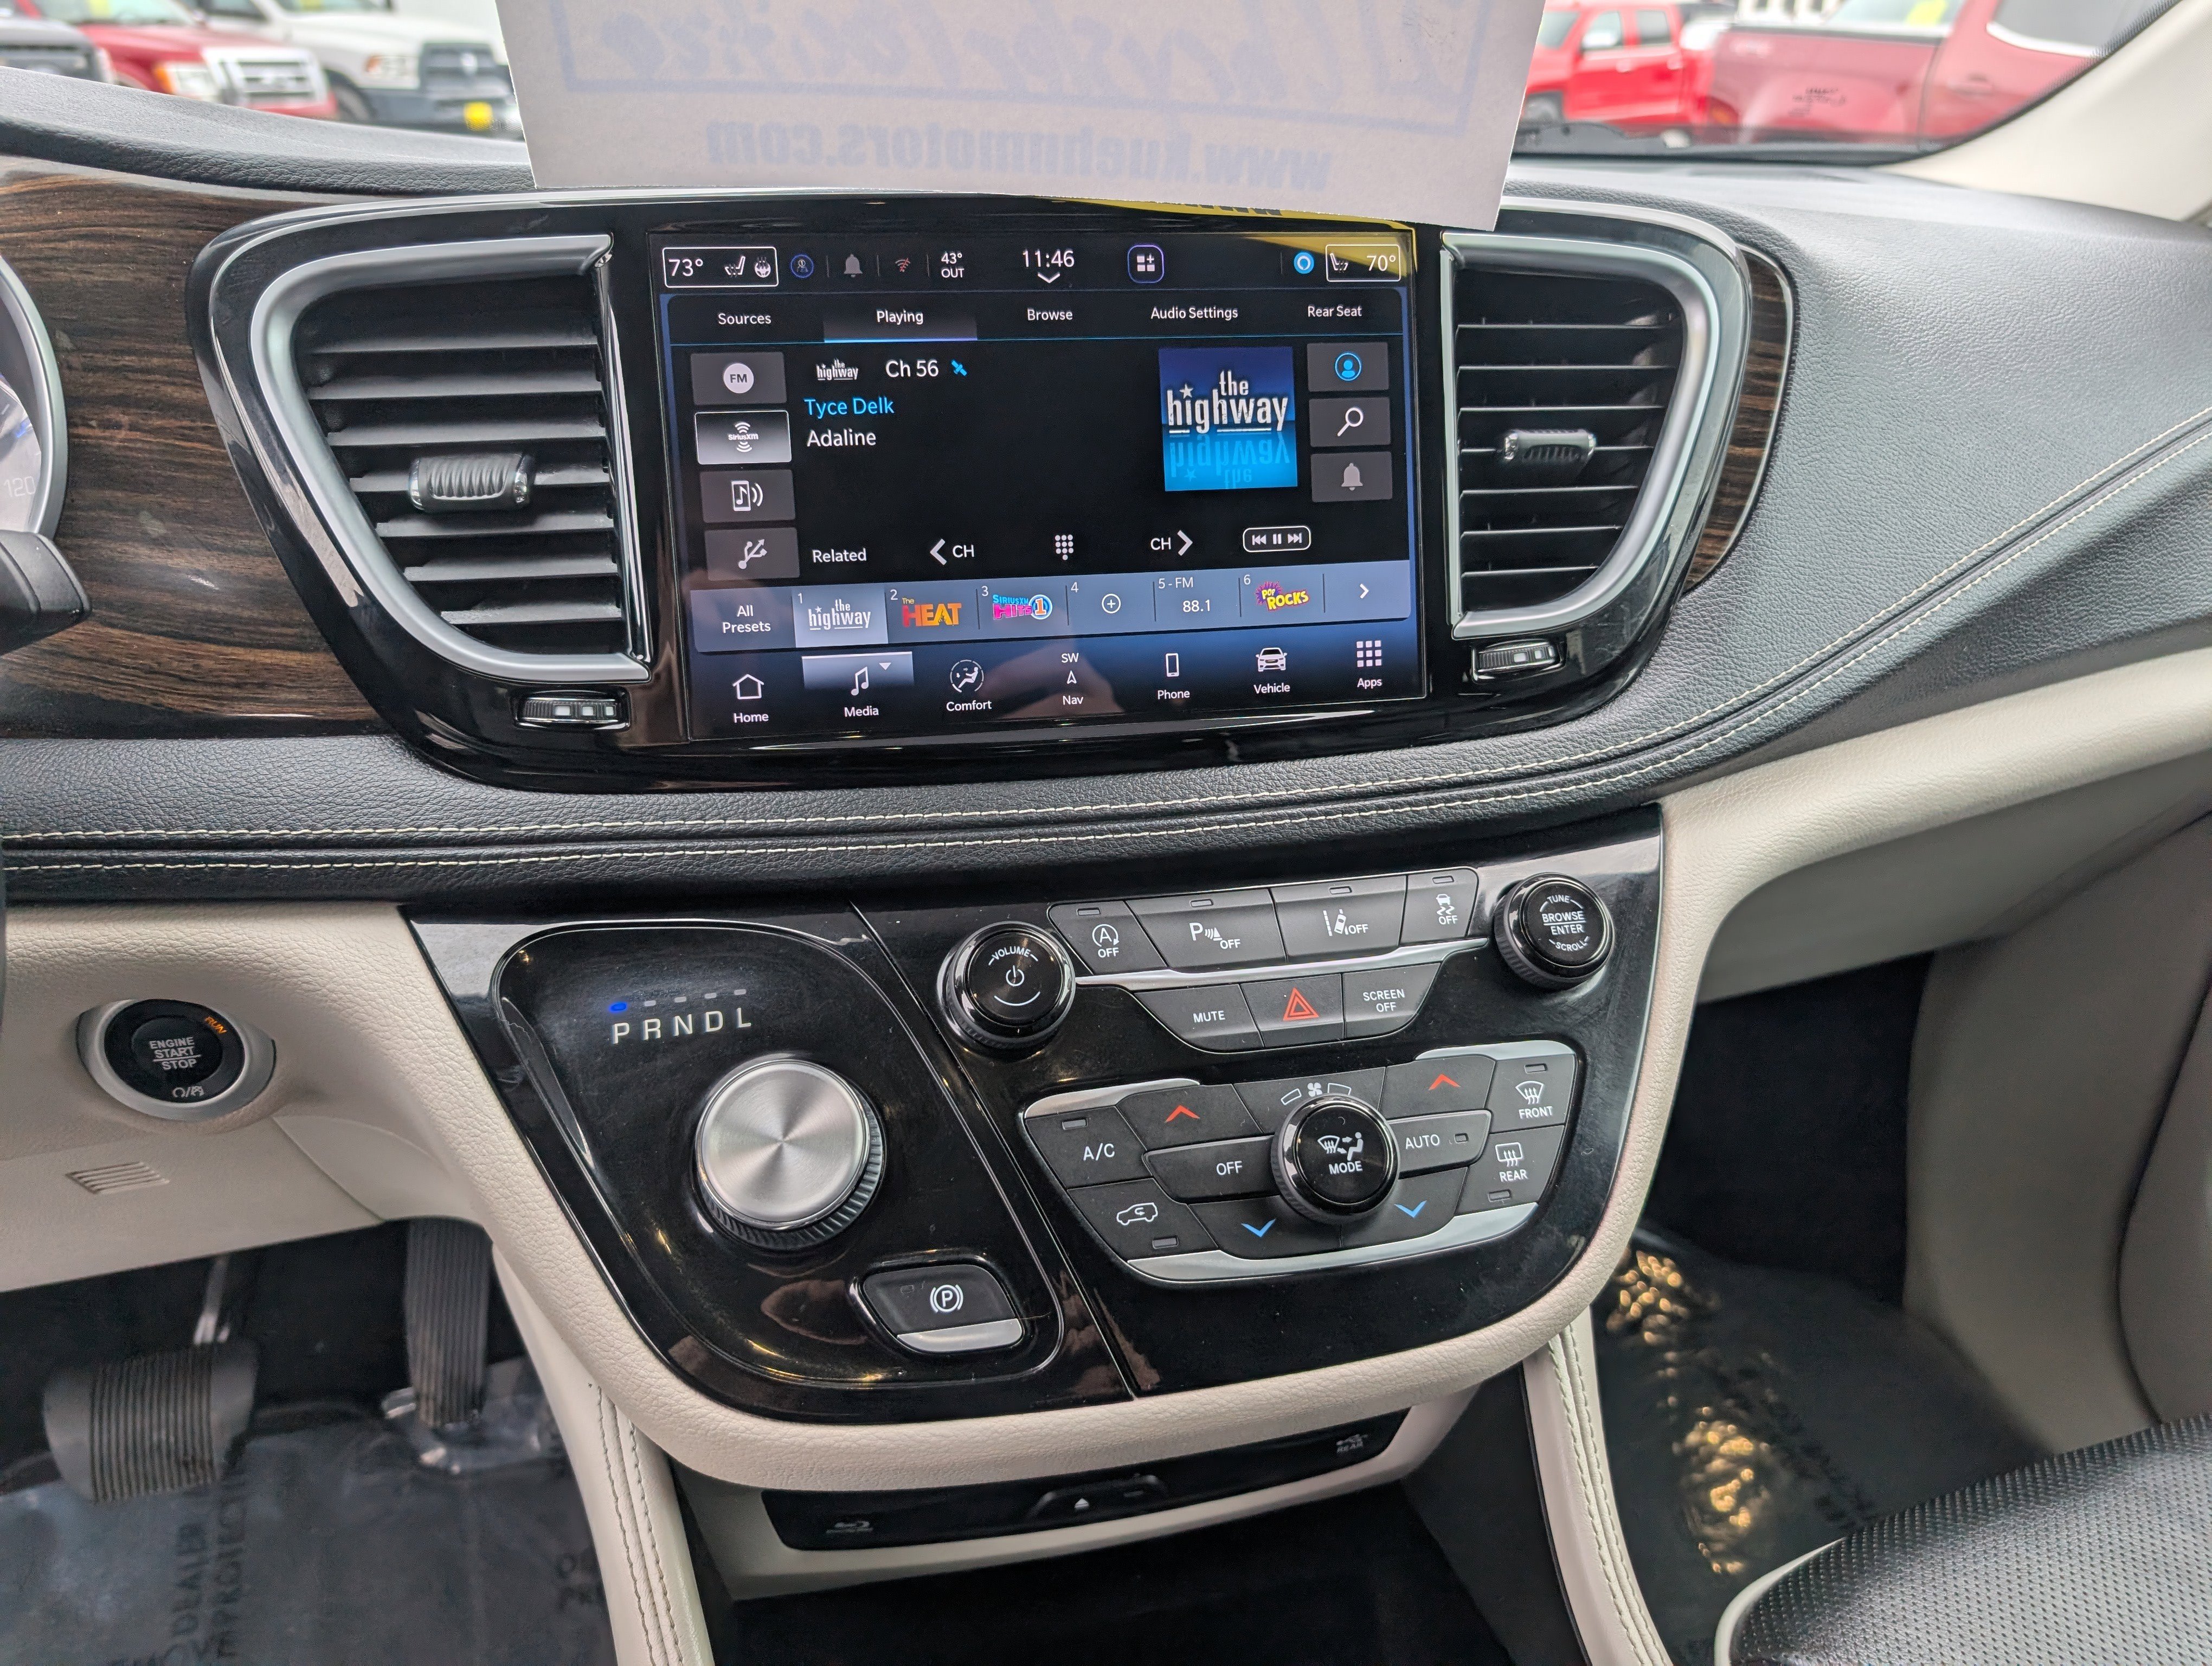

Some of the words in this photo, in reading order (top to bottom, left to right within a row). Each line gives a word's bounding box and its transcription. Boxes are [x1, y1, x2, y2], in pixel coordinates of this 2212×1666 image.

[941, 252, 962, 264] 43°
[1023, 249, 1074, 267] 11:46
[1367, 255, 1396, 271] 70°
[669, 259, 703, 276] 73°
[942, 268, 964, 278] OUT
[1027, 309, 1072, 321] Browse
[1151, 307, 1186, 319] Audio
[1189, 306, 1238, 321] Settings
[1308, 306, 1334, 317] Rear
[1336, 305, 1362, 316] Seat
[718, 313, 771, 324] Sources
[877, 310, 923, 325] Playing
[834, 358, 845, 368] the
[886, 360, 910, 377] Ch
[917, 360, 938, 377] 56
[816, 364, 858, 380] highway
[730, 374, 748, 383] FM
[1219, 370, 1248, 395] the
[804, 399, 847, 419] Tyce
[853, 398, 894, 414] Delk
[1167, 385, 1288, 433] highway
[807, 428, 876, 446] Adaline
[4, 476, 36, 497] 120
[1151, 537, 1171, 550] CH
[813, 548, 866, 562] Related
[953, 545, 974, 558] CH
[1175, 577, 1193, 588] FM
[1244, 574, 1250, 585] 6
[981, 586, 988, 597] 3
[1071, 582, 1078, 592] 4
[798, 593, 802, 604] 1
[890, 589, 898, 600] 2
[1267, 591, 1309, 610] ROCKS
[737, 605, 753, 617] All
[835, 599, 850, 611] the
[1183, 600, 1210, 612] 88.1
[809, 607, 871, 630] highway
[902, 603, 962, 627] HEAT
[723, 621, 770, 633] Presets
[1062, 653, 1079, 663] SW
[1253, 683, 1290, 694] Vehicle
[1357, 678, 1382, 689] Apps
[1063, 695, 1083, 705] Nav
[1158, 690, 1189, 699] Phone
[845, 706, 879, 717] Media
[947, 700, 992, 711] Comfort
[734, 713, 768, 723] Home
[1547, 895, 1570, 904] TUNE
[1438, 914, 1458, 925] OFF
[1542, 911, 1584, 922] BROWSE
[1189, 922, 1203, 940] P
[1348, 924, 1368, 934] OFF
[1551, 924, 1584, 935] ENTER
[1220, 939, 1240, 950] OFF
[1555, 940, 1587, 952] SCROLL
[992, 946, 1031, 960] VOLUME
[1097, 947, 1119, 958] OFF
[1364, 989, 1405, 1002] SCREEN
[1376, 1002, 1396, 1013] OFF
[1193, 1010, 1225, 1022] MUTE
[205, 1016, 227, 1034] RUN
[612, 1023, 629, 1044] P
[643, 1018, 660, 1040] R
[673, 1014, 692, 1036] N
[704, 1011, 723, 1032] D
[737, 1008, 751, 1028] L
[149, 1037, 195, 1049] ENGINE
[155, 1046, 195, 1059] START
[162, 1059, 197, 1070] STOP
[1519, 1106, 1552, 1119] FRONT
[1406, 1135, 1440, 1149] AUTO
[1083, 1143, 1115, 1161] A/C
[1217, 1161, 1242, 1175] OFF
[1329, 1160, 1362, 1174] MODE
[1500, 1169, 1528, 1182] REAR
